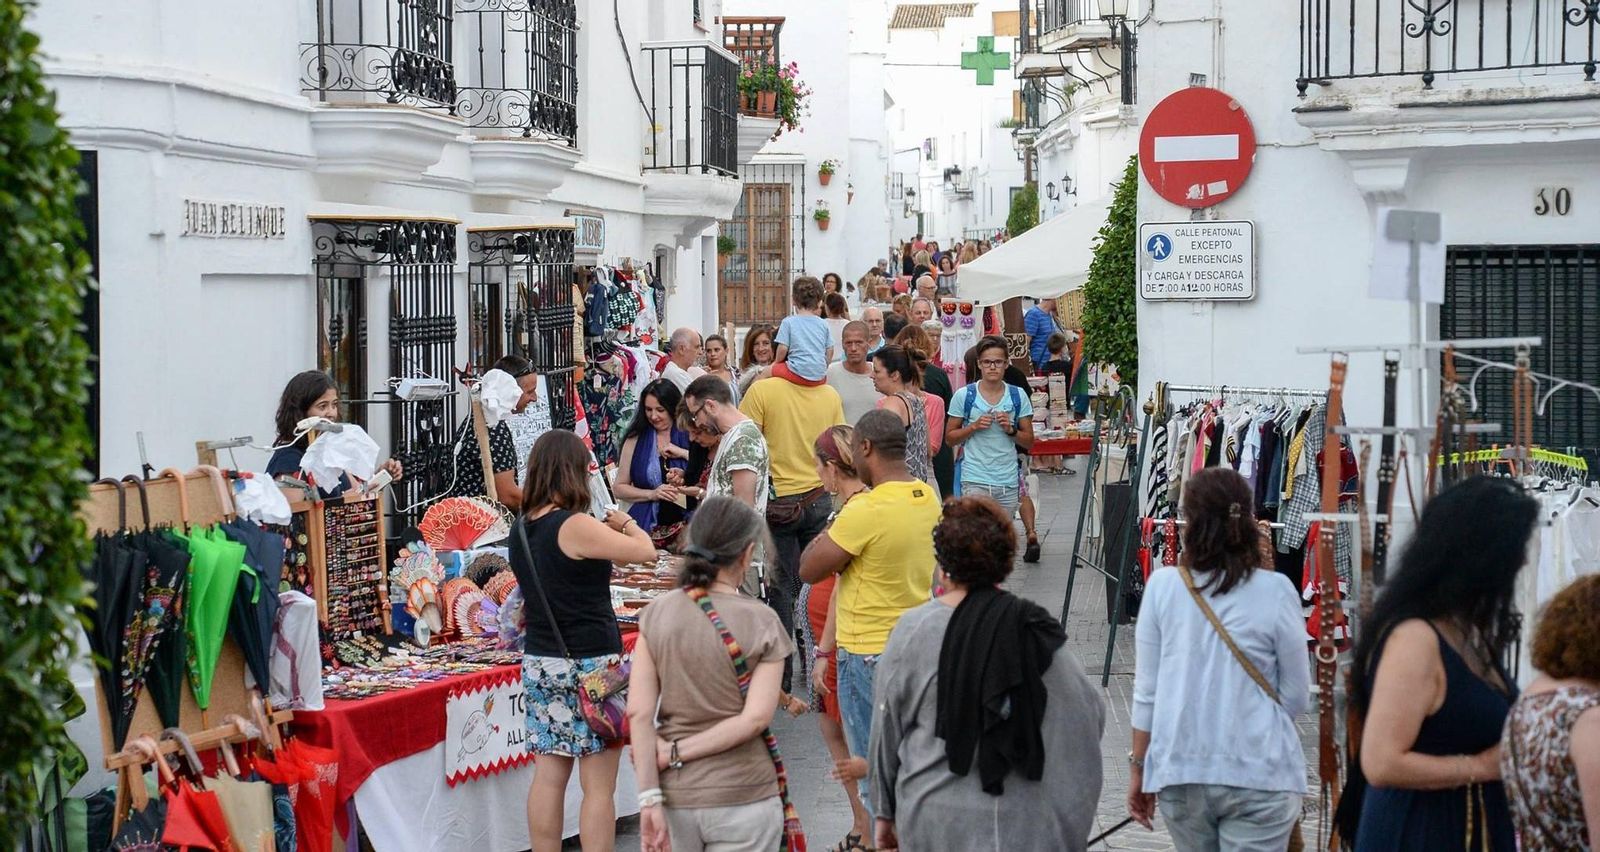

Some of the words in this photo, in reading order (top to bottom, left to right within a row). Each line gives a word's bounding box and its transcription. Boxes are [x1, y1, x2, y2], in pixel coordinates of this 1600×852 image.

[183, 199, 217, 236] JUAN
[1175, 228, 1200, 237] CALLE
[1202, 228, 1243, 236] PEATONAL
[1191, 240, 1233, 250] EXCEPTO
[1178, 254, 1244, 264] EMERGENCIAS
[1147, 272, 1152, 280] Y
[1154, 271, 1184, 280] CARGA
[1186, 271, 1192, 280] Y
[1194, 270, 1244, 280] DESCARGA
[1145, 283, 1157, 292] DE
[1213, 282, 1244, 292] HORAS
